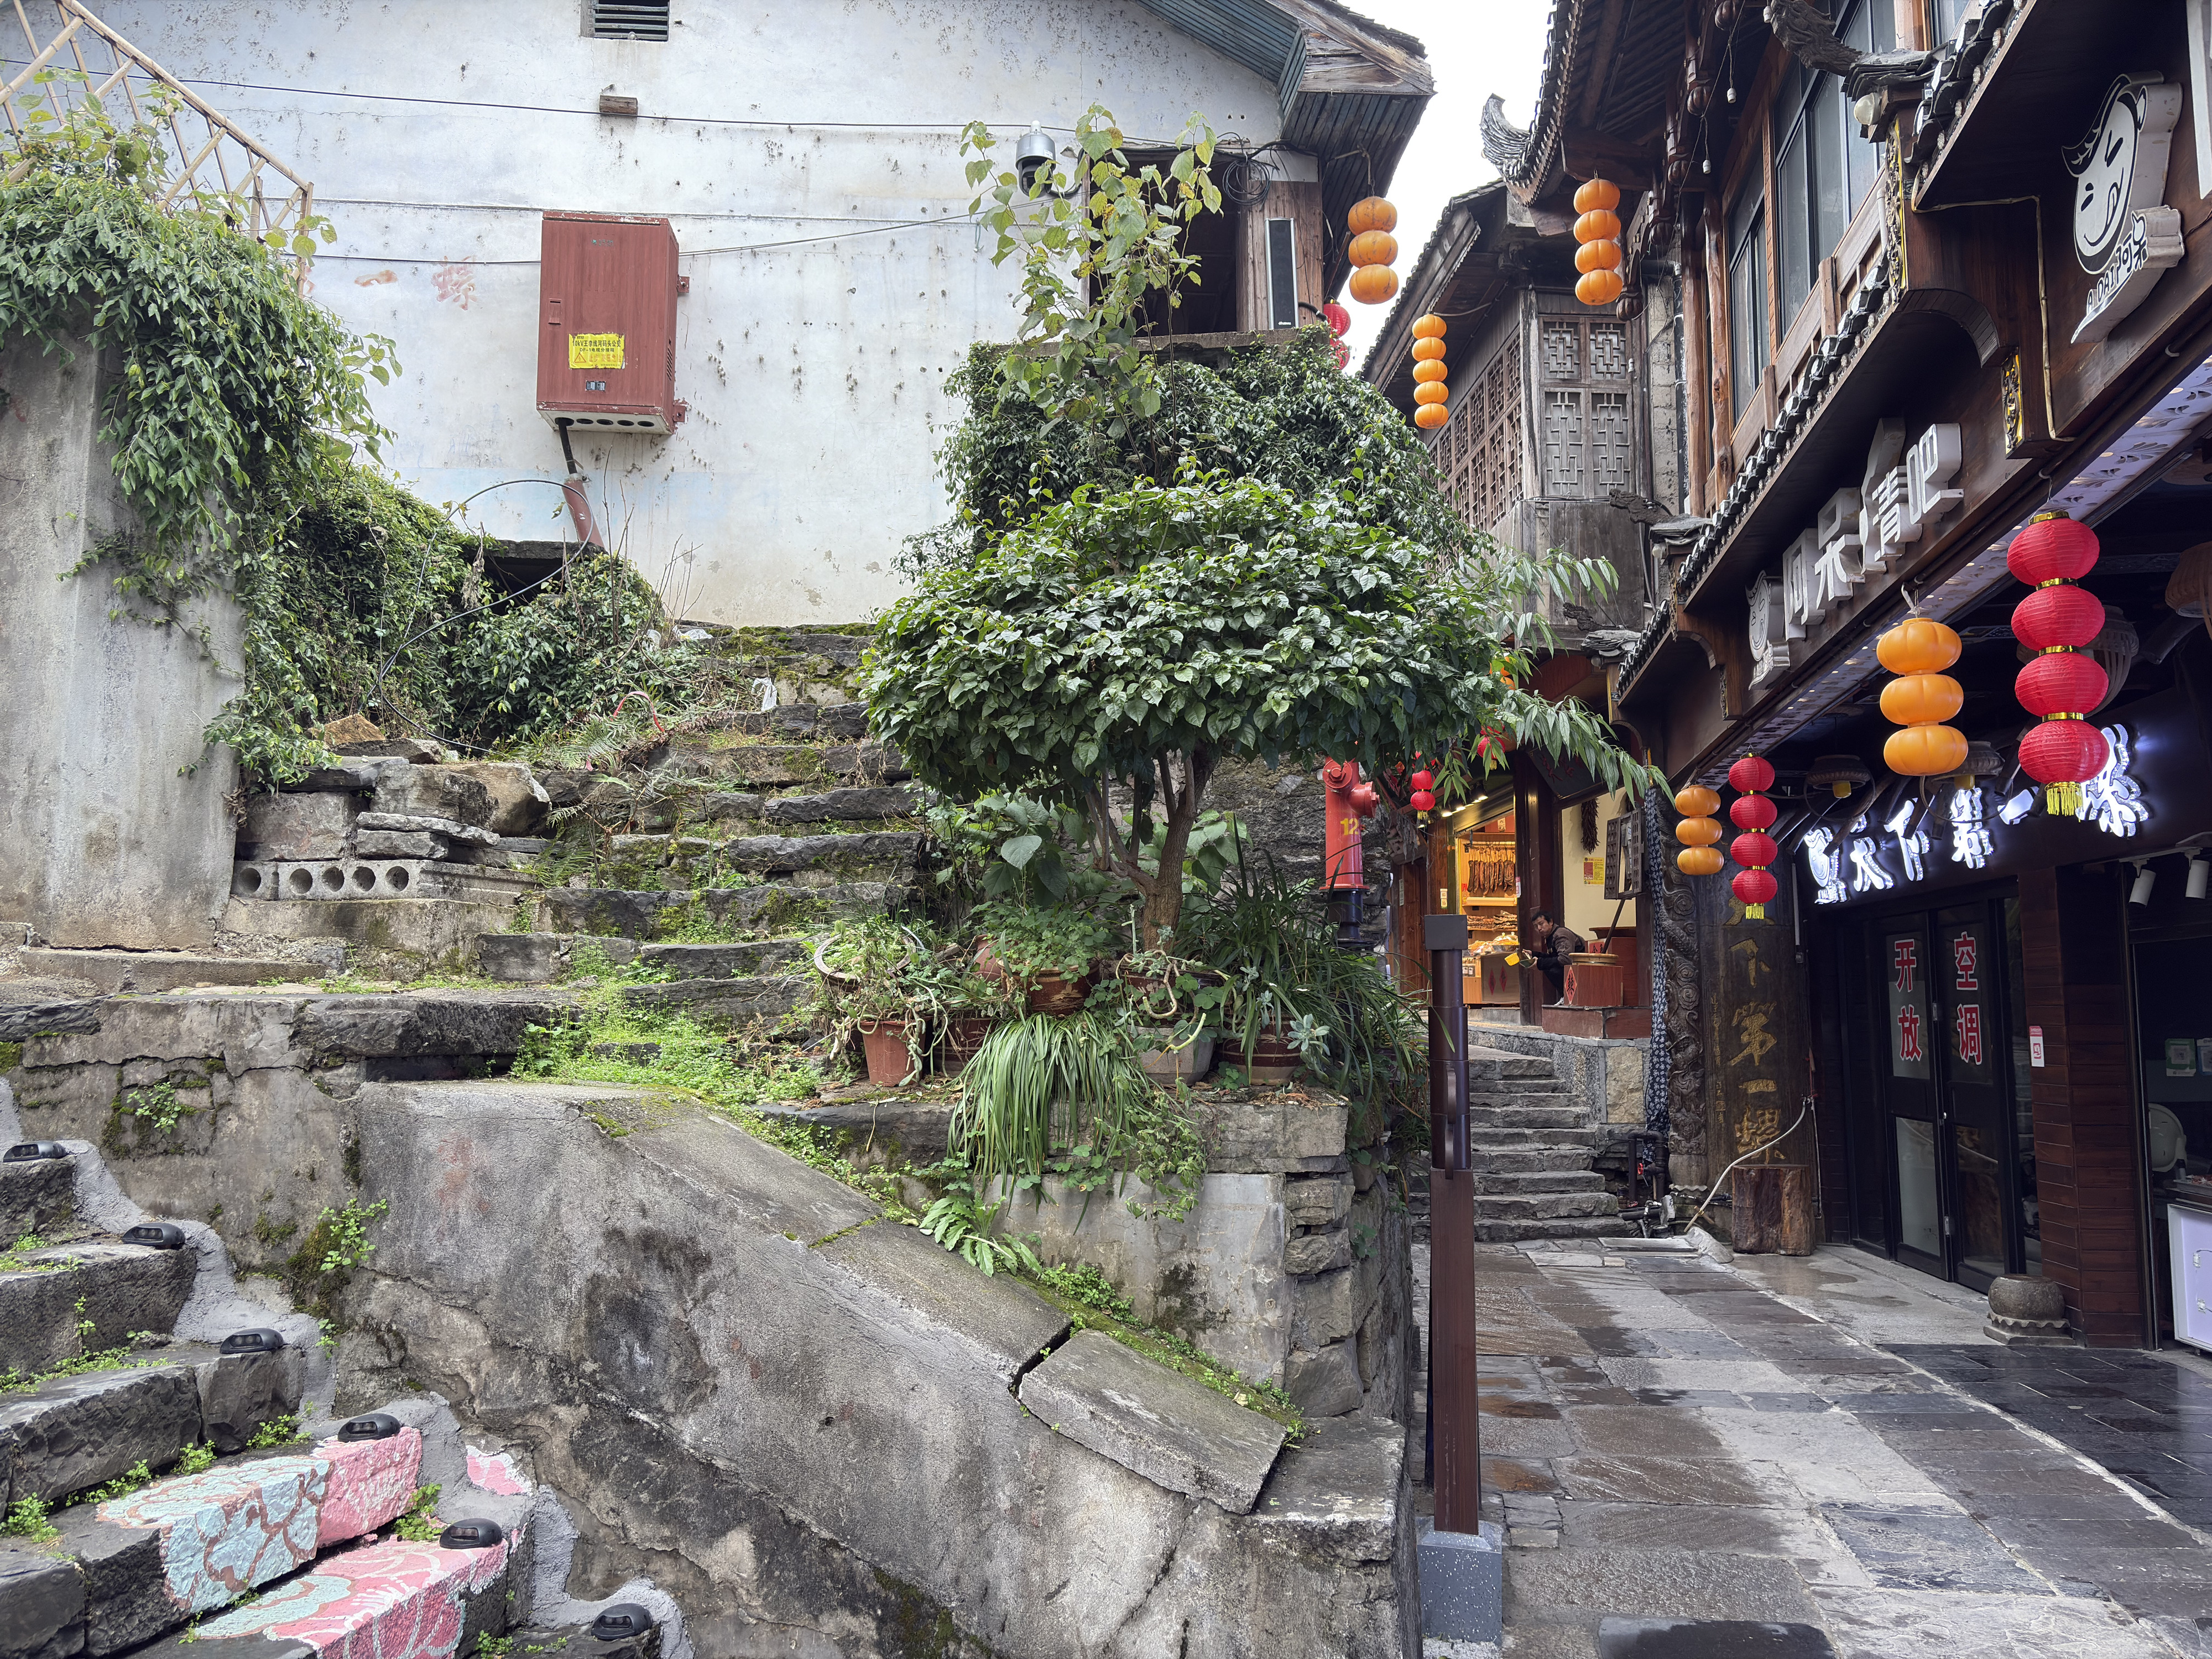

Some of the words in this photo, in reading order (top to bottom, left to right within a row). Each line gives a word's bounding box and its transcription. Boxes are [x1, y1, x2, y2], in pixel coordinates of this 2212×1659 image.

[1340, 818, 1359, 835] 12
[1894, 938, 1922, 1062] 开放
[1954, 931, 1983, 1065] 空调
